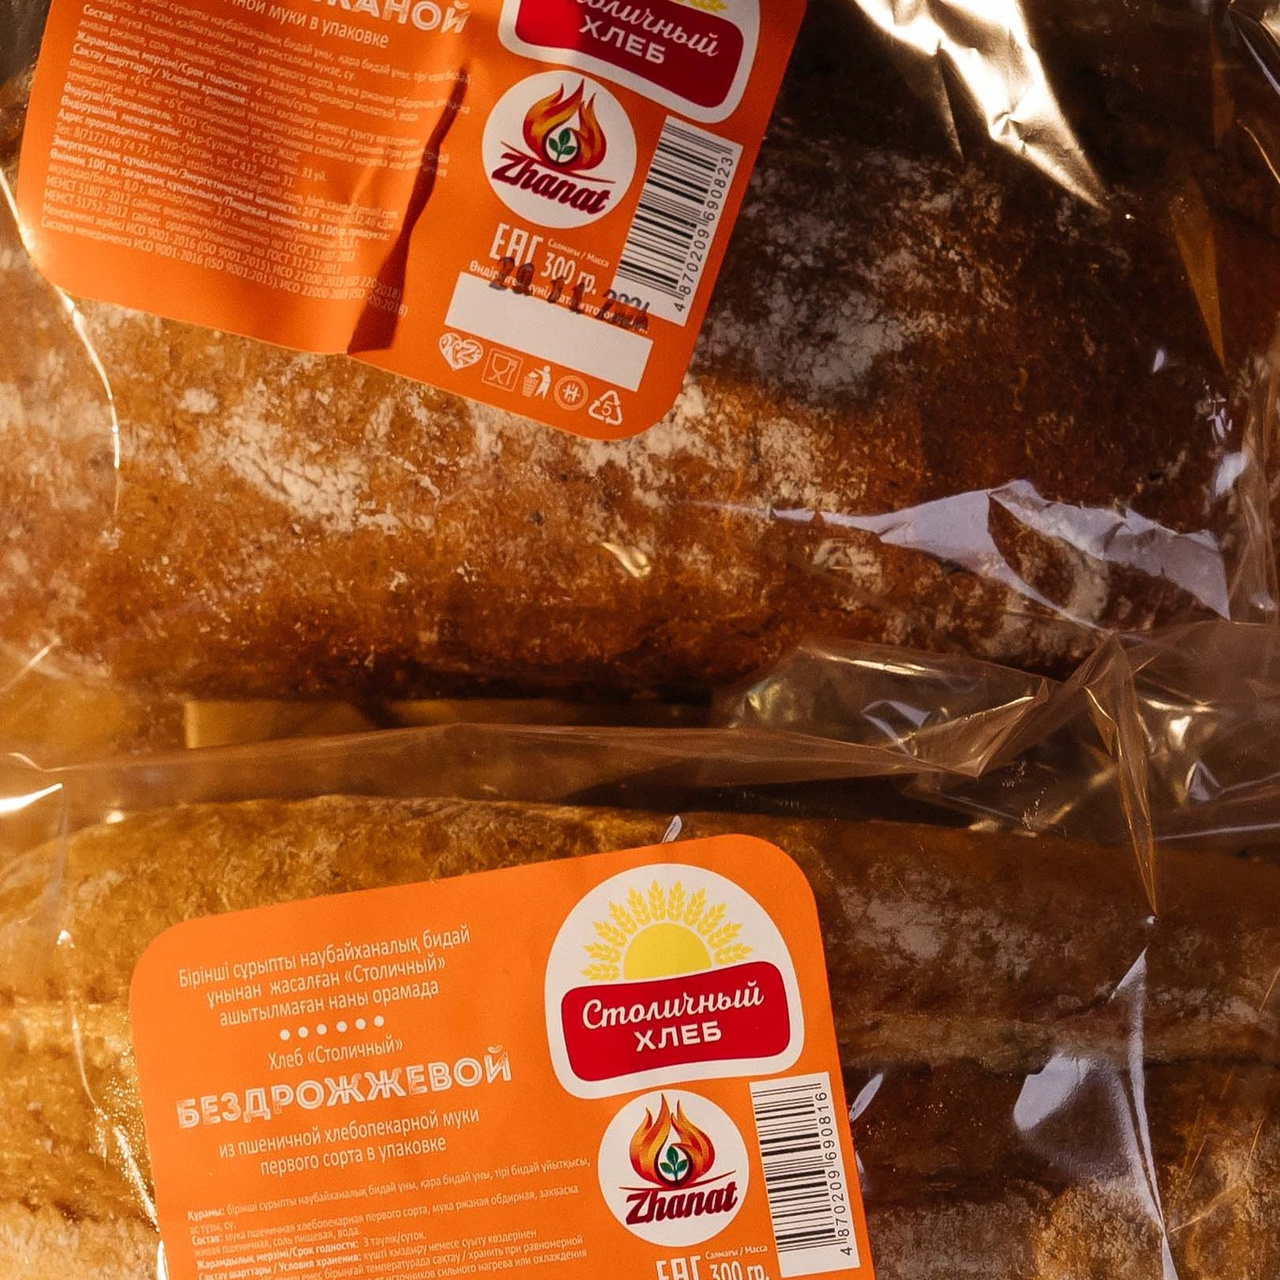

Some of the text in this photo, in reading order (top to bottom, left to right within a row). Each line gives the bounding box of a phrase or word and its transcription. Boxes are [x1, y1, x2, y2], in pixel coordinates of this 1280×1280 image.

[267, 3, 308, 28] муки
[308, 14, 320, 31] в
[319, 18, 390, 50] упаковке
[577, 13, 667, 65] ХЛЕБ
[491, 153, 611, 216] Zhanat
[544, 251, 575, 284] 300
[177, 922, 471, 990] Бірінші сұрыпты наубайханалық бидай
[343, 951, 447, 984] «Столичный»
[327, 990, 370, 1011] наны
[371, 979, 440, 1007] орамада
[581, 979, 765, 1030] Столичный
[266, 1033, 404, 1072] Хлеб «Столичный»
[633, 1019, 722, 1052] ХЛЕБ
[175, 1043, 513, 1130] БЕЗДРОЖЖЕВОЙ
[217, 1107, 481, 1159] из пшеничной хлебопекарной муки
[258, 1135, 447, 1179] первого сорта в упаковке
[624, 1179, 742, 1226] Zhanat
